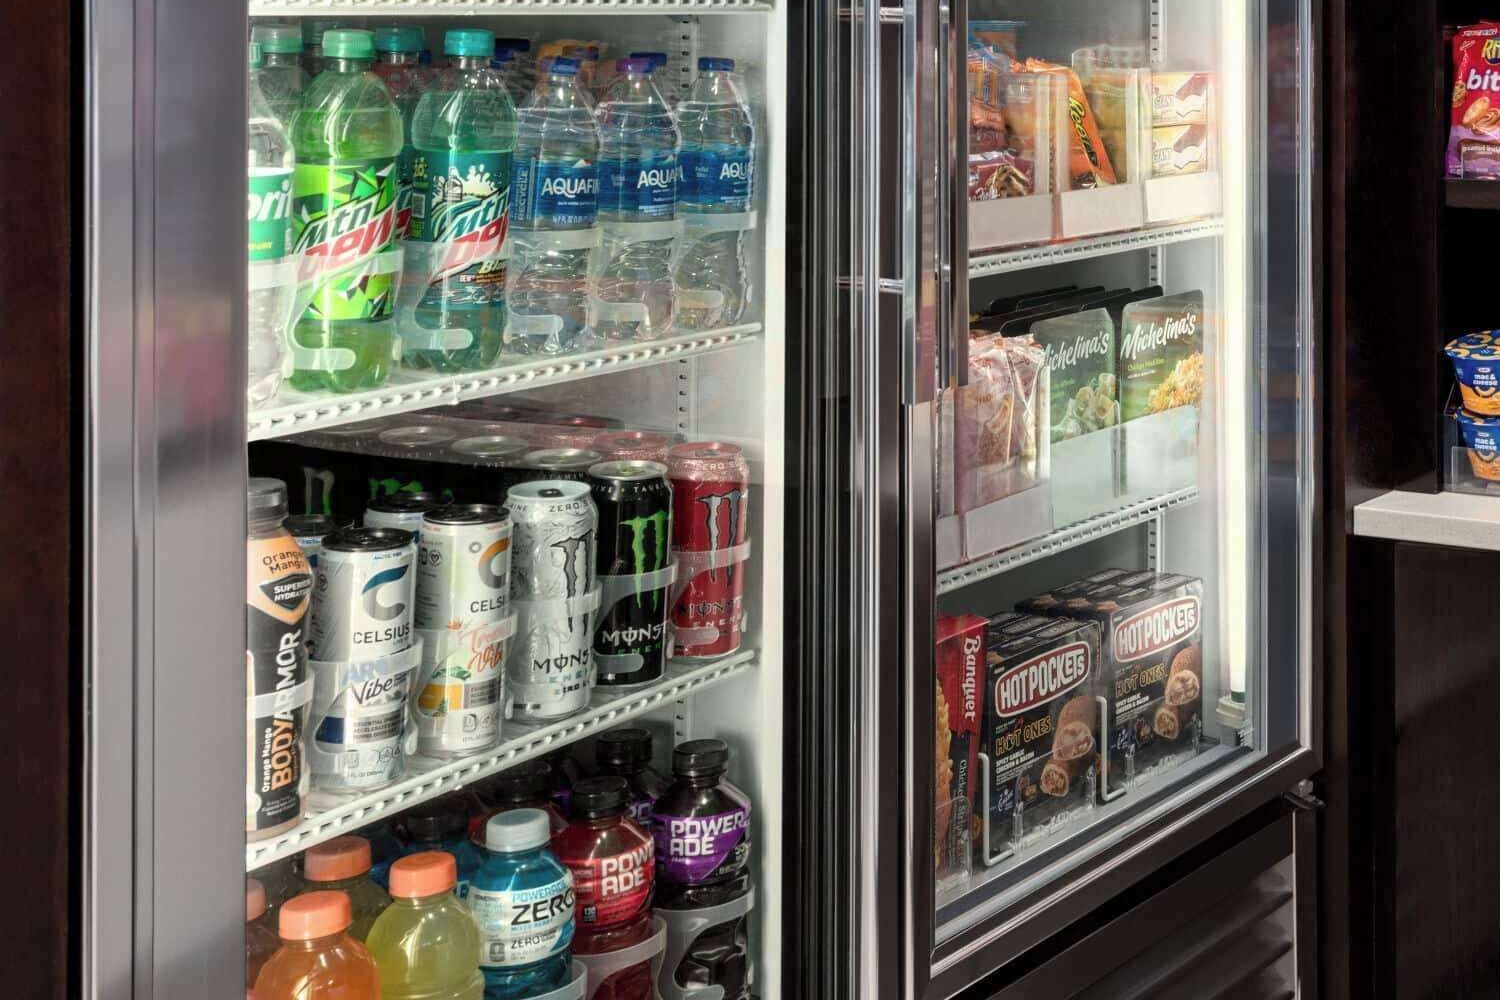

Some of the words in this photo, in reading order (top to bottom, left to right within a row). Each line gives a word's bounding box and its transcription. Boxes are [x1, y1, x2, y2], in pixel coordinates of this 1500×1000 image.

[541, 177, 599, 198] AQUAFI
[1120, 312, 1196, 360] Michelina's
[549, 503, 580, 513] ZERO
[352, 623, 411, 645] CELSIUS
[1118, 623, 1144, 655] HOT
[1144, 604, 1196, 648] POCKETS
[351, 678, 394, 705] Vibe
[962, 636, 982, 722] Banquet
[1000, 676, 1029, 712] HOT
[1029, 649, 1086, 700] POCKETS
[272, 629, 301, 791] BODYARMOR
[262, 727, 272, 758] Mango
[262, 760, 271, 792] Orange
[670, 837, 714, 857] ADE
[602, 868, 645, 897] ADE
[512, 888, 576, 926] ZERO
[511, 936, 540, 949] ZERO
